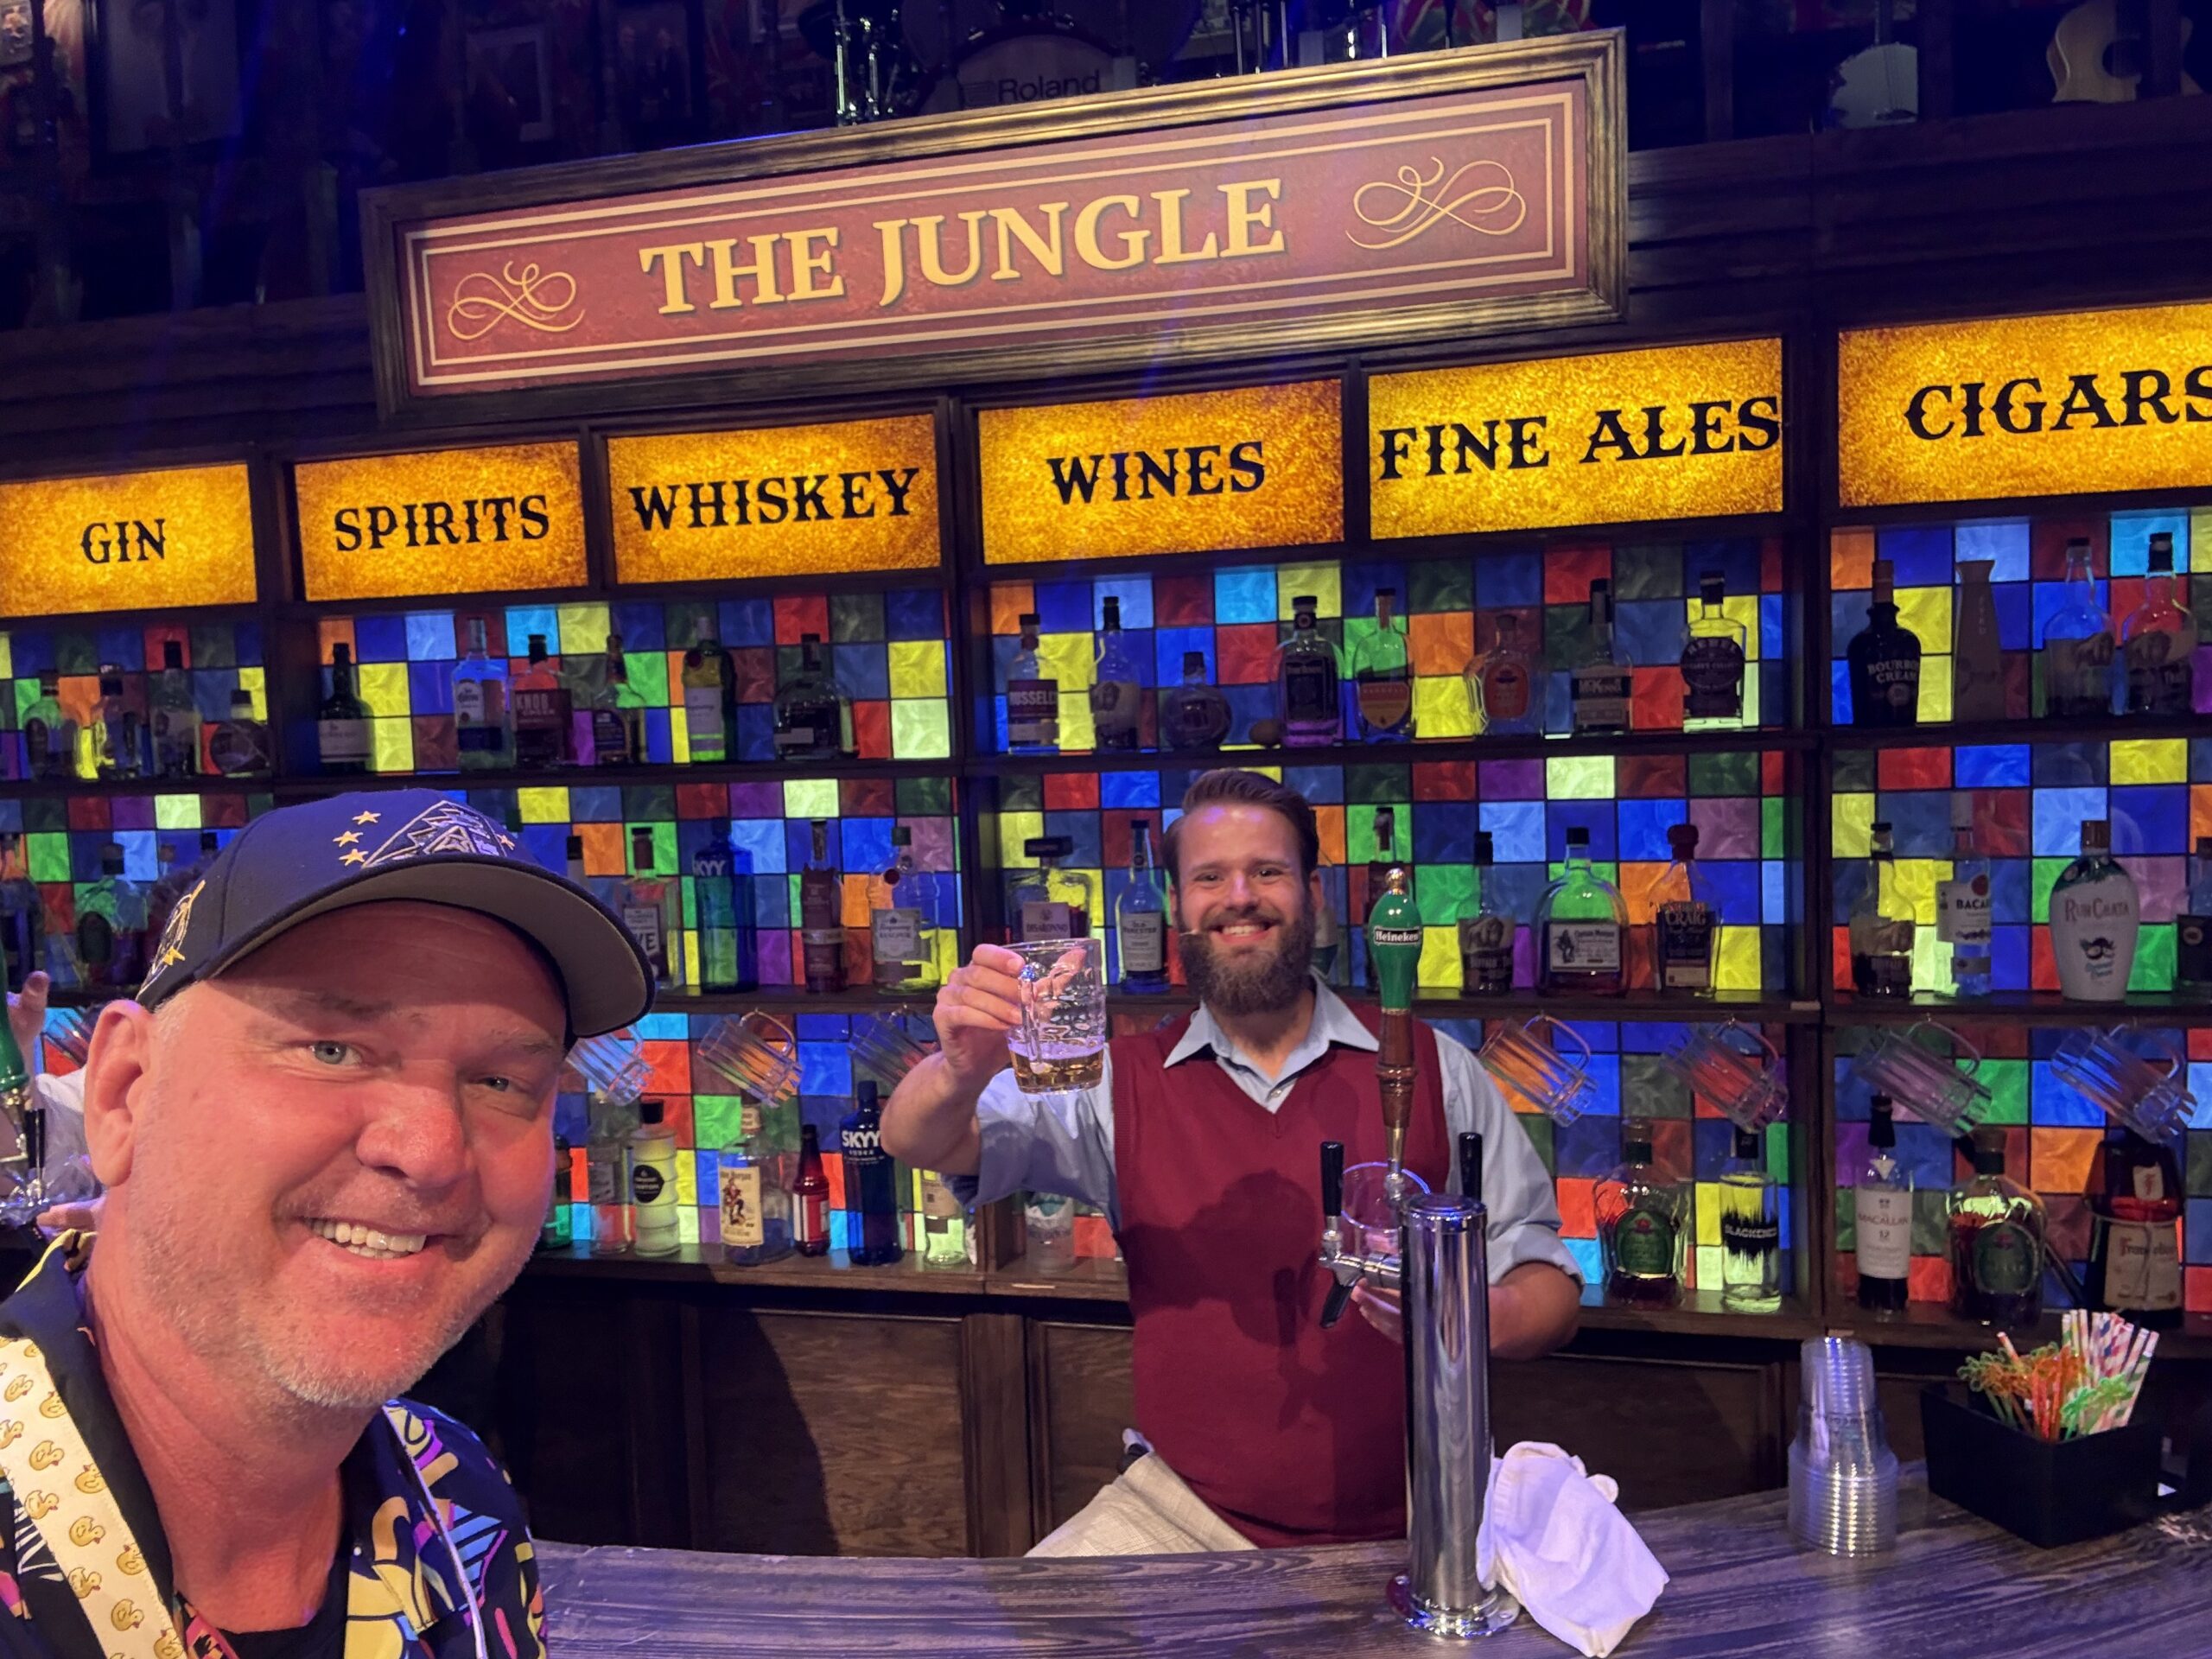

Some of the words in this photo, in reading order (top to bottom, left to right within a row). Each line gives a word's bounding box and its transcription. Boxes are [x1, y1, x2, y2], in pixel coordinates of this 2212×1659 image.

[998, 69, 1100, 102] Roland
[639, 226, 846, 315] THE
[873, 177, 1286, 308] JUNGLE
[1904, 365, 2212, 442] CIGARS
[1379, 416, 1550, 480] FINE
[1580, 396, 1782, 464] ALES
[1046, 441, 1266, 505] WINES
[333, 494, 550, 551] SPIRITS
[628, 467, 920, 531] WHISKEY
[79, 518, 167, 564] GIN
[1867, 658, 1919, 676] BOURBO
[693, 860, 726, 876] KYY
[1376, 930, 1419, 942] Heineken
[842, 1129, 880, 1148] SKYY
